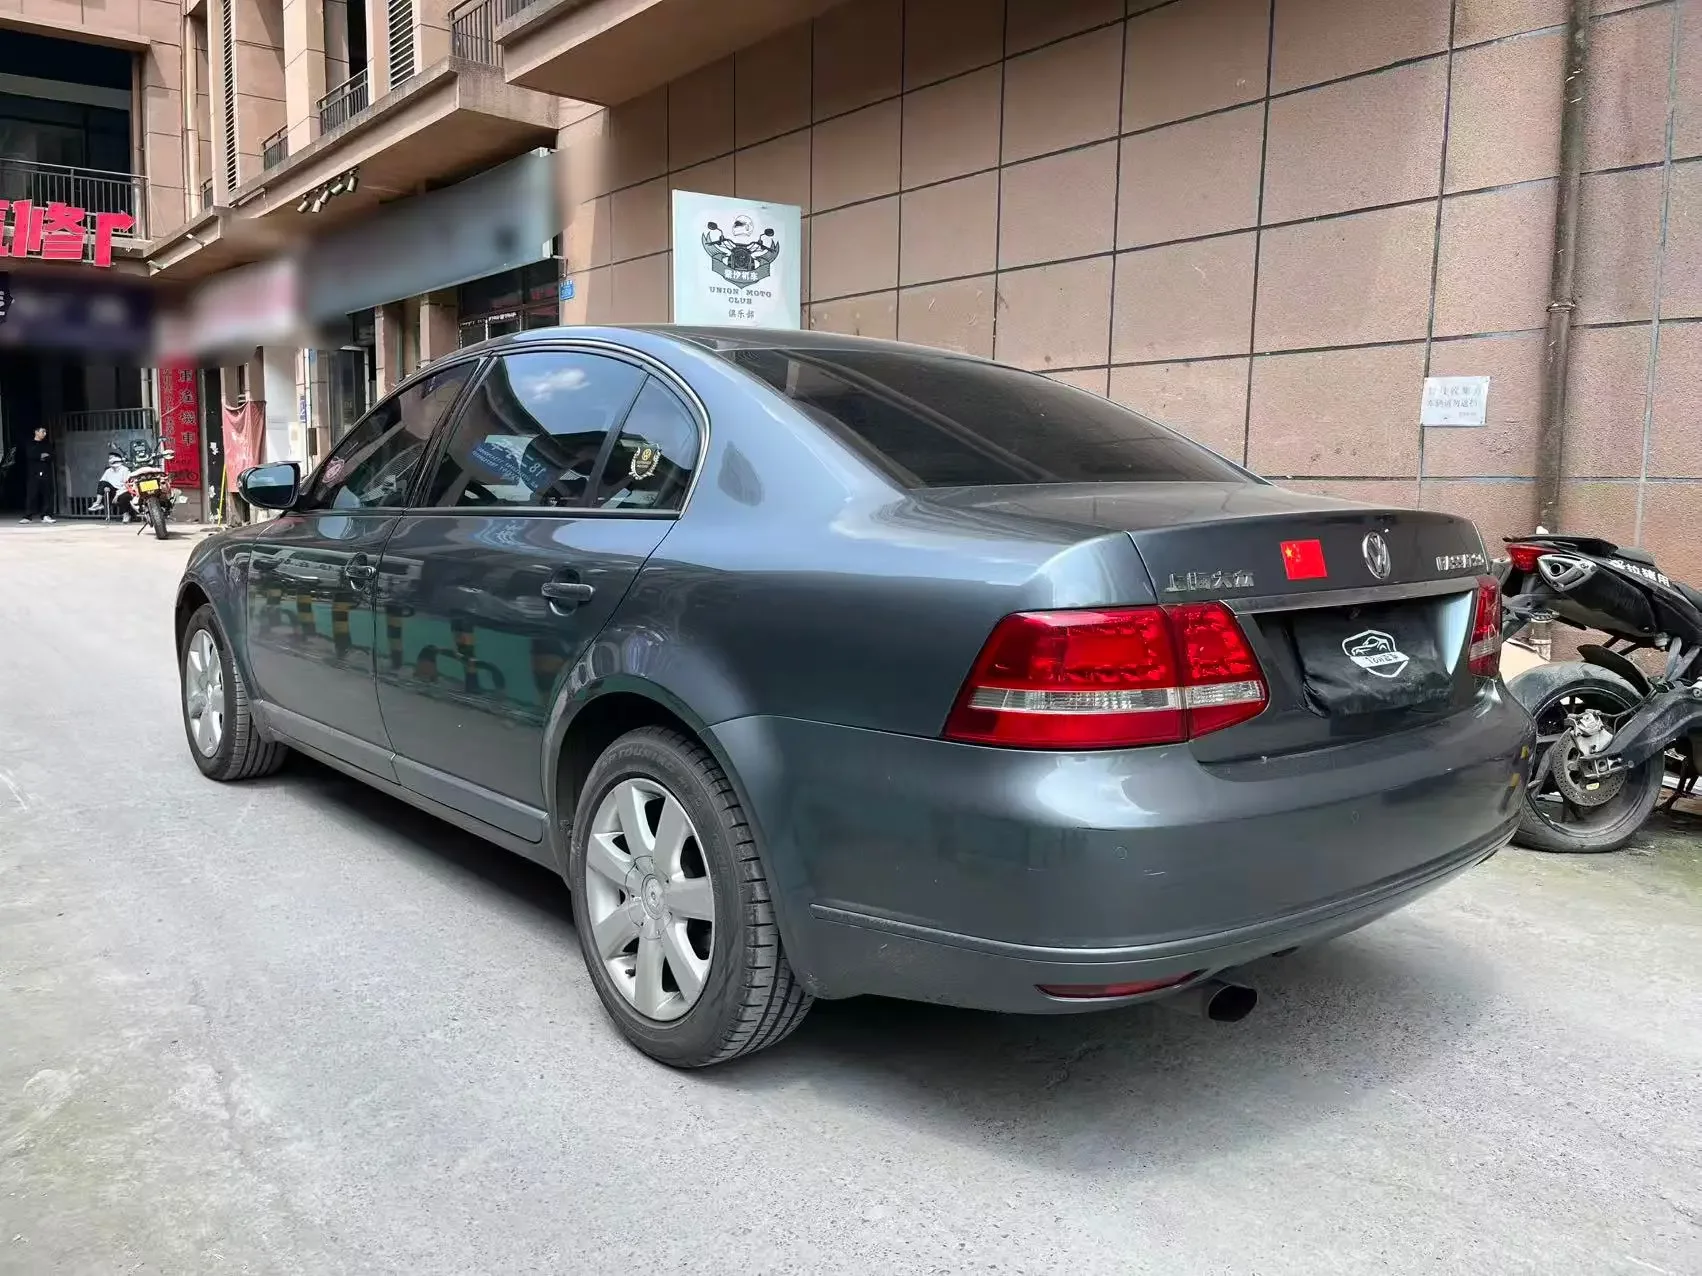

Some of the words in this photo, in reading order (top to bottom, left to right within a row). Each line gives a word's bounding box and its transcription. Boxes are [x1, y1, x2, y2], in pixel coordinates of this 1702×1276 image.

[0, 199, 136, 268] 修厂
[709, 286, 739, 295] UNION
[746, 290, 772, 298] MOTO
